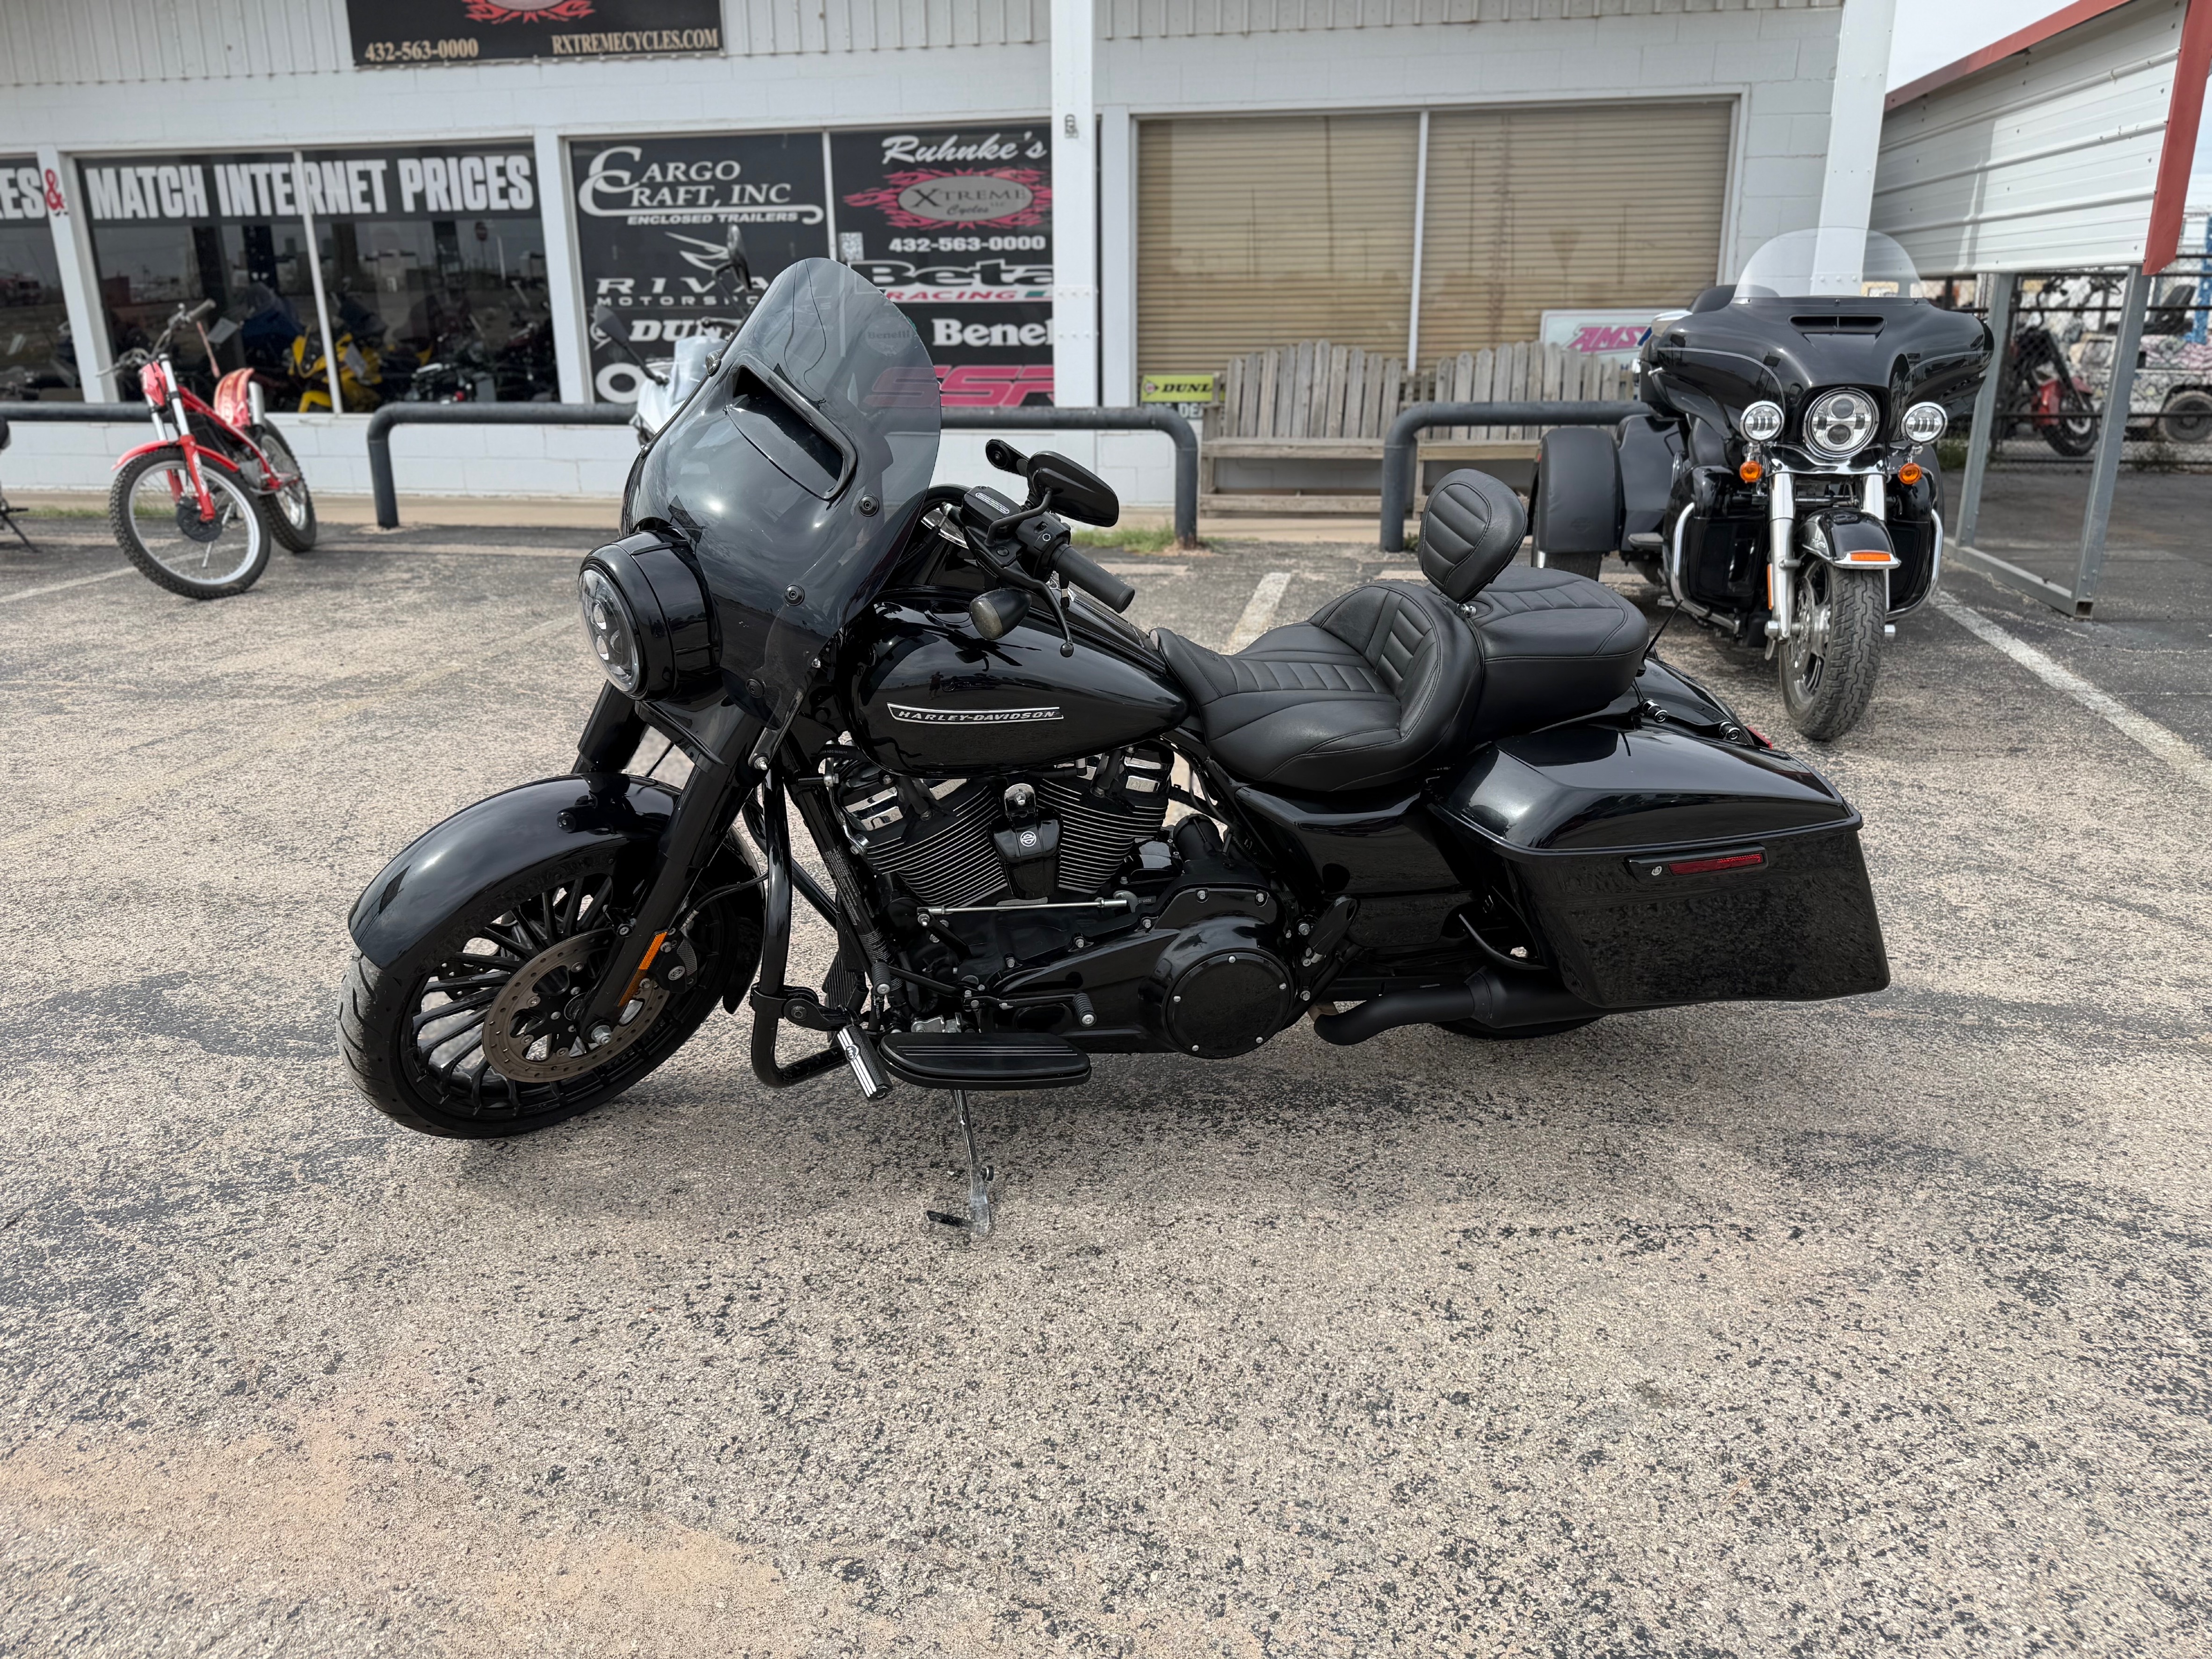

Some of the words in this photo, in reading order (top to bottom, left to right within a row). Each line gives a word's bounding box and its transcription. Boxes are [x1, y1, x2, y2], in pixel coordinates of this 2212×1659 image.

[365, 38, 479, 62] 432-563-0000
[551, 28, 719, 55] RXTREMECYCLES.COM
[881, 131, 1047, 164] Ruhnke's
[588, 146, 741, 193] CARGO
[0, 167, 46, 219] ES
[85, 165, 209, 220] MATCH
[214, 160, 388, 217] INTERNET
[398, 155, 534, 213] PRICES
[729, 183, 791, 204] INC
[910, 188, 1027, 208] XTREME
[627, 214, 713, 226] ENCLOSED
[717, 212, 798, 223] TRAILERS
[946, 204, 989, 217] Cycles
[889, 235, 1046, 253] 432-563-0000
[885, 290, 1017, 300] RACING
[932, 318, 1054, 347] Benel
[1567, 327, 1652, 352] AMS
[1161, 383, 1226, 393] DUNL
[898, 711, 1055, 721] HARLEY-DAVIDSON
